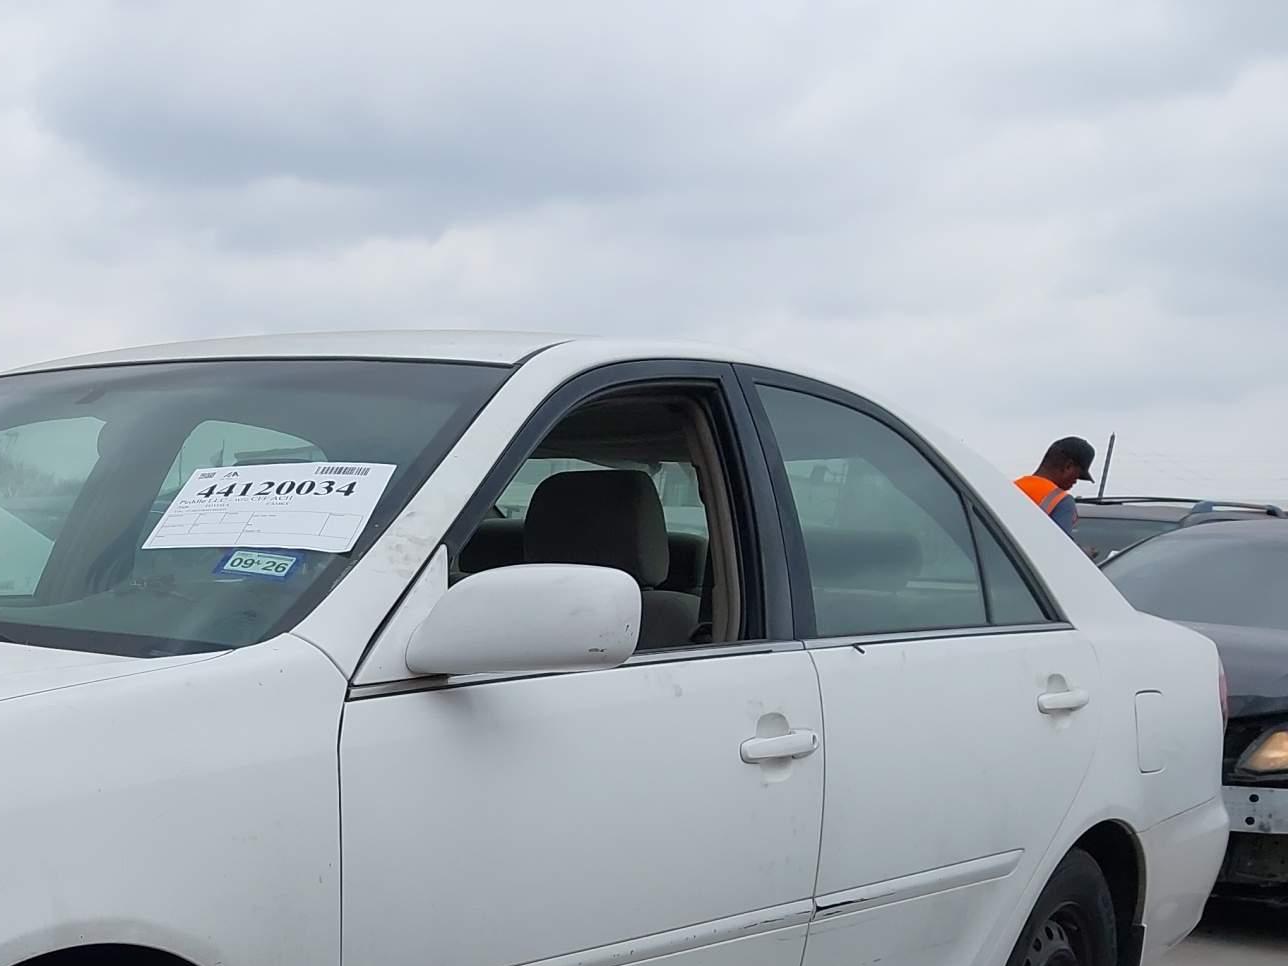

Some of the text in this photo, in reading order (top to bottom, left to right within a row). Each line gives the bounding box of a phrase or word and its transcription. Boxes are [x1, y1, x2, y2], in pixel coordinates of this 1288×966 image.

[197, 480, 356, 498] 44120034
[230, 557, 288, 573] 09 26
